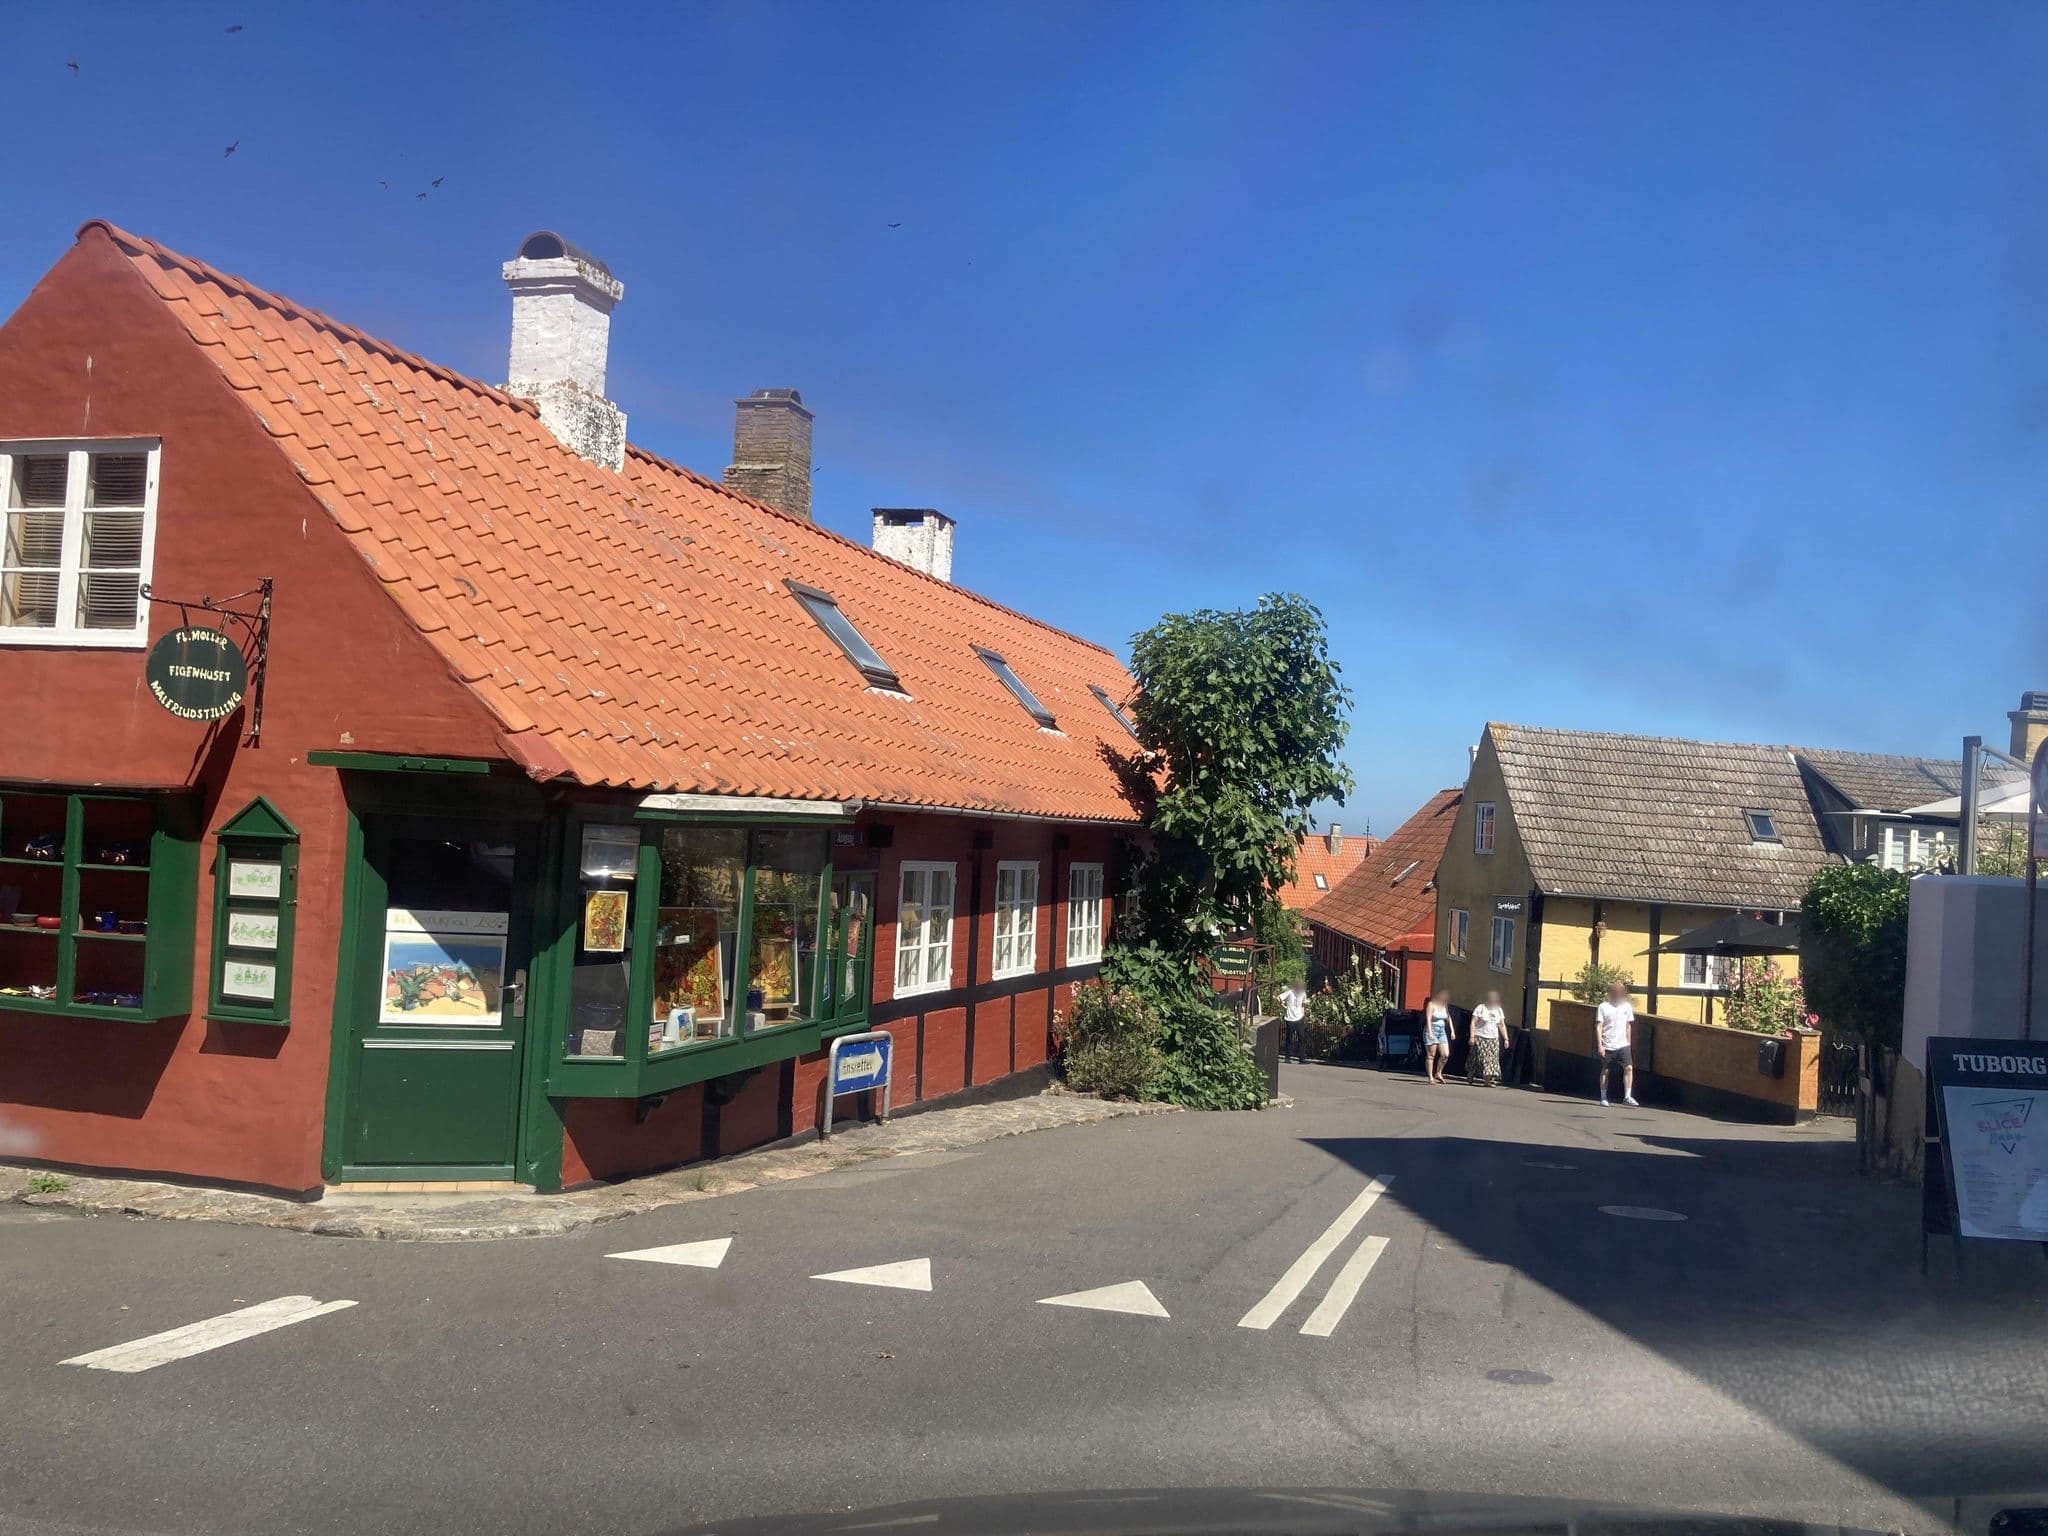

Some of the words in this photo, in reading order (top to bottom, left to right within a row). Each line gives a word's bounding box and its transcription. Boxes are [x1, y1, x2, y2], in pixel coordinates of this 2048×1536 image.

[169, 665, 231, 682] FIGENHUSET
[150, 680, 242, 720] MALERIUDSTILLING
[1953, 1053, 2047, 1075] TUBORG
